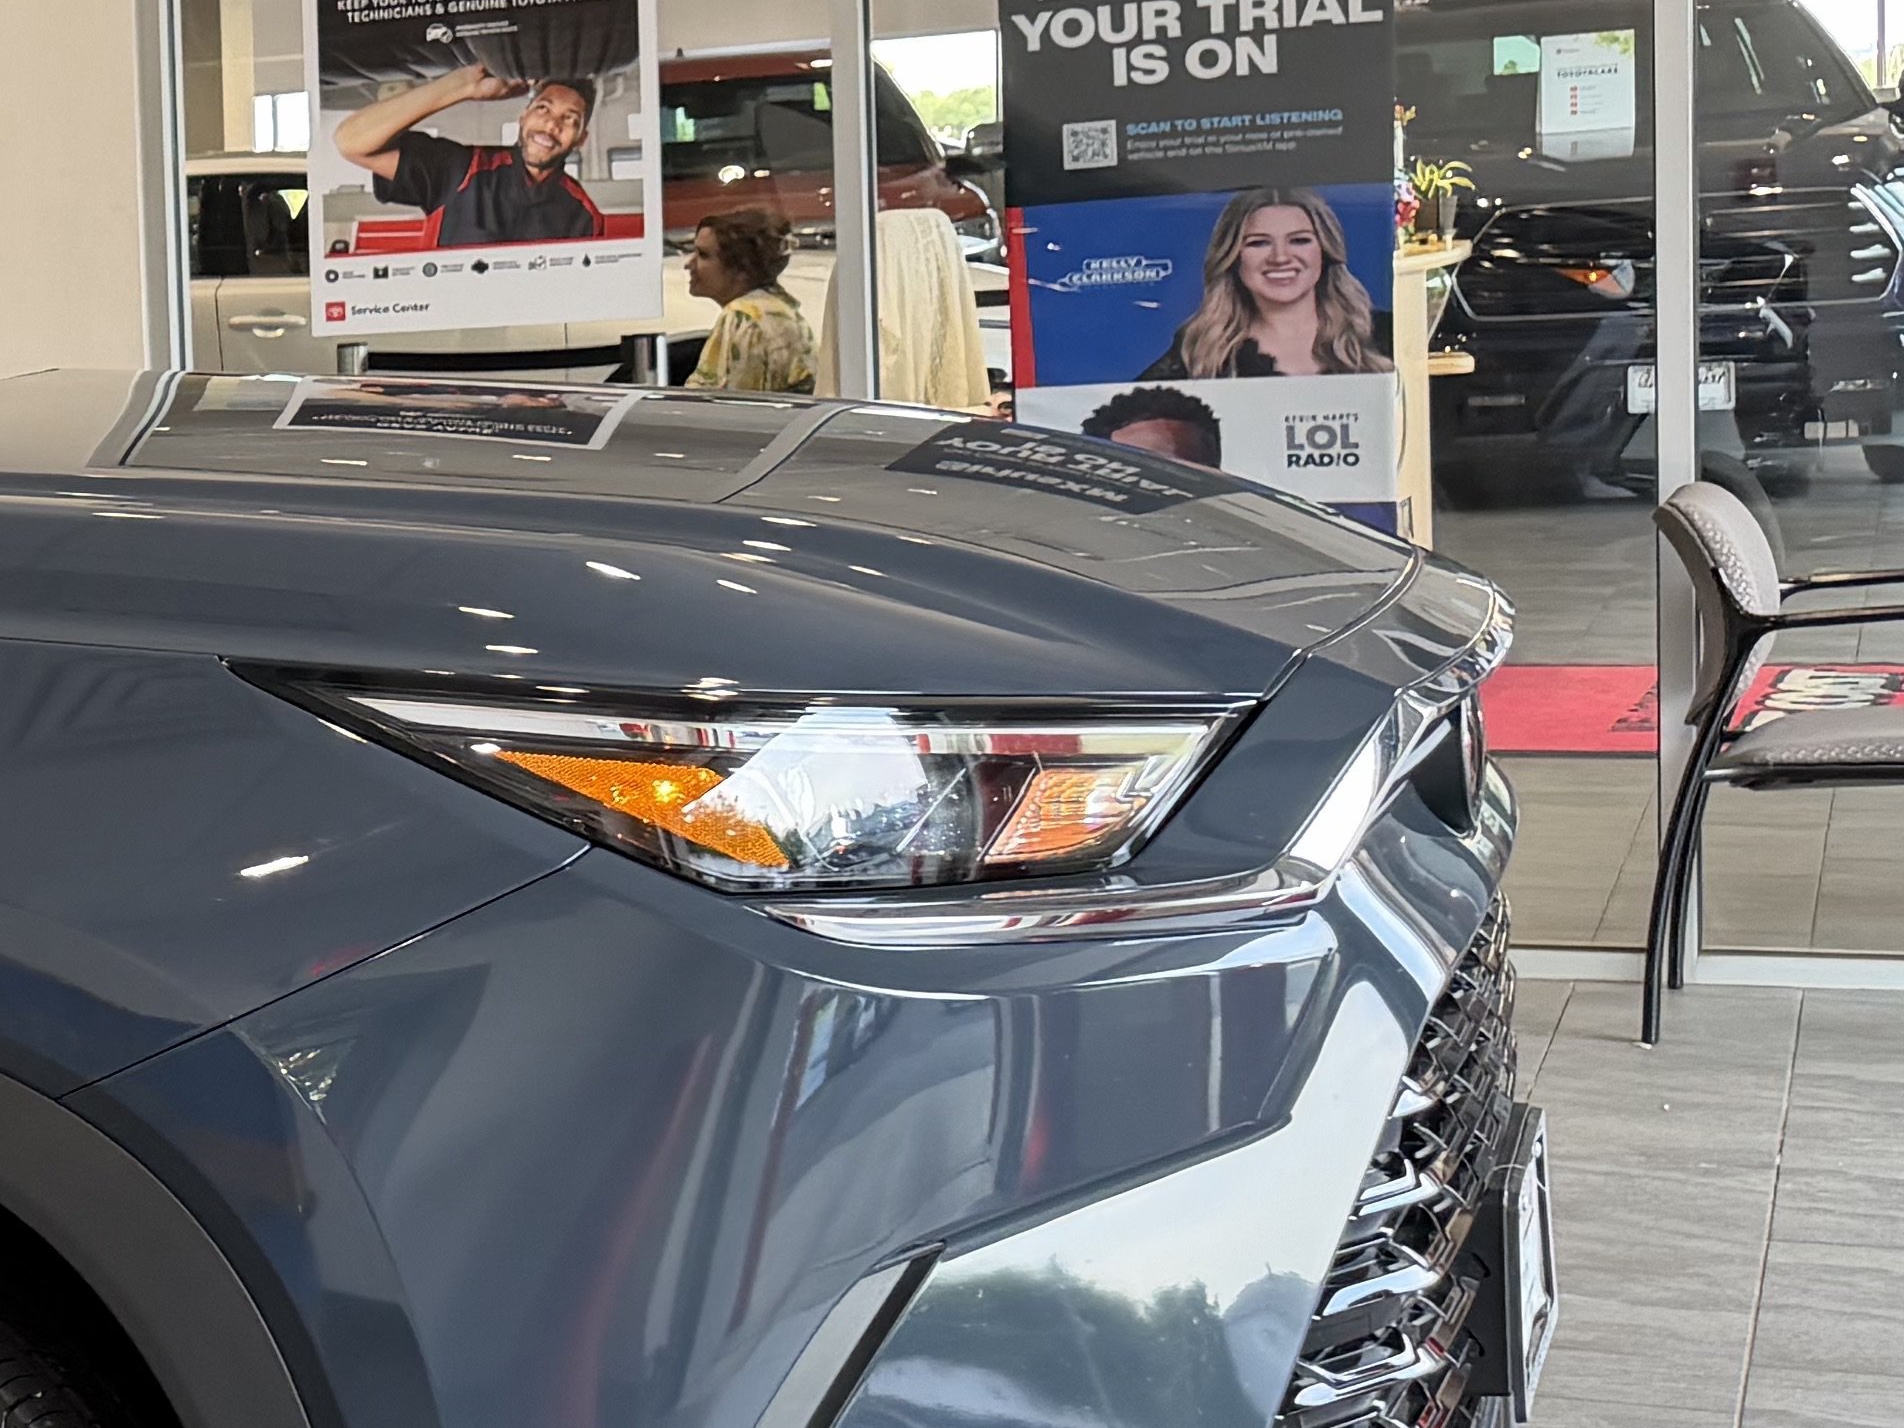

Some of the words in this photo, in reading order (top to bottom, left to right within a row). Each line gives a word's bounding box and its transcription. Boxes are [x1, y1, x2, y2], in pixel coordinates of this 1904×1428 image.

[347, 3, 432, 23] TECHNICIANS
[435, 4, 444, 15] &
[1011, 0, 1182, 52] YOUR
[1112, 43, 1170, 86] IS
[1185, 33, 1278, 80] ON
[1125, 122, 1171, 136] SCAN
[1175, 120, 1196, 132] TO
[1199, 115, 1252, 130] START
[1256, 109, 1343, 127] LISTENING
[393, 302, 430, 313] Center
[1285, 423, 1360, 451] LOL
[1287, 452, 1360, 468] RADIO
